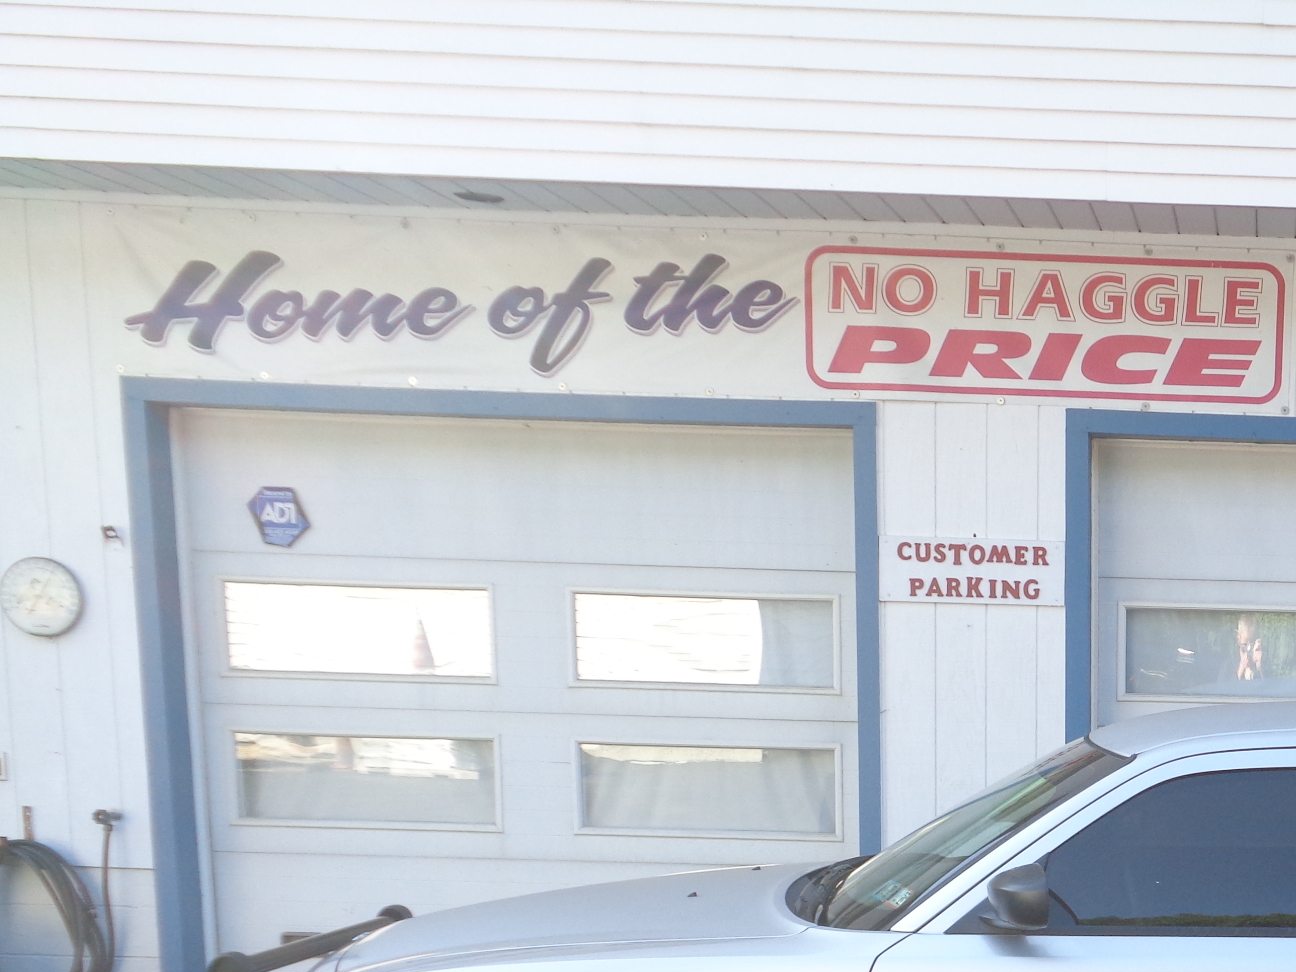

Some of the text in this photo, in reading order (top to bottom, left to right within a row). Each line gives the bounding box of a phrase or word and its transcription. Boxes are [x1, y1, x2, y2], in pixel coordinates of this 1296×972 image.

[125, 250, 799, 377] Home of the
[828, 261, 1264, 328] NO HAGGLE
[827, 325, 1263, 388] PRICE
[260, 501, 296, 524] ADT
[897, 542, 1049, 566] CUSTOMER
[909, 576, 1041, 600] PARKING
